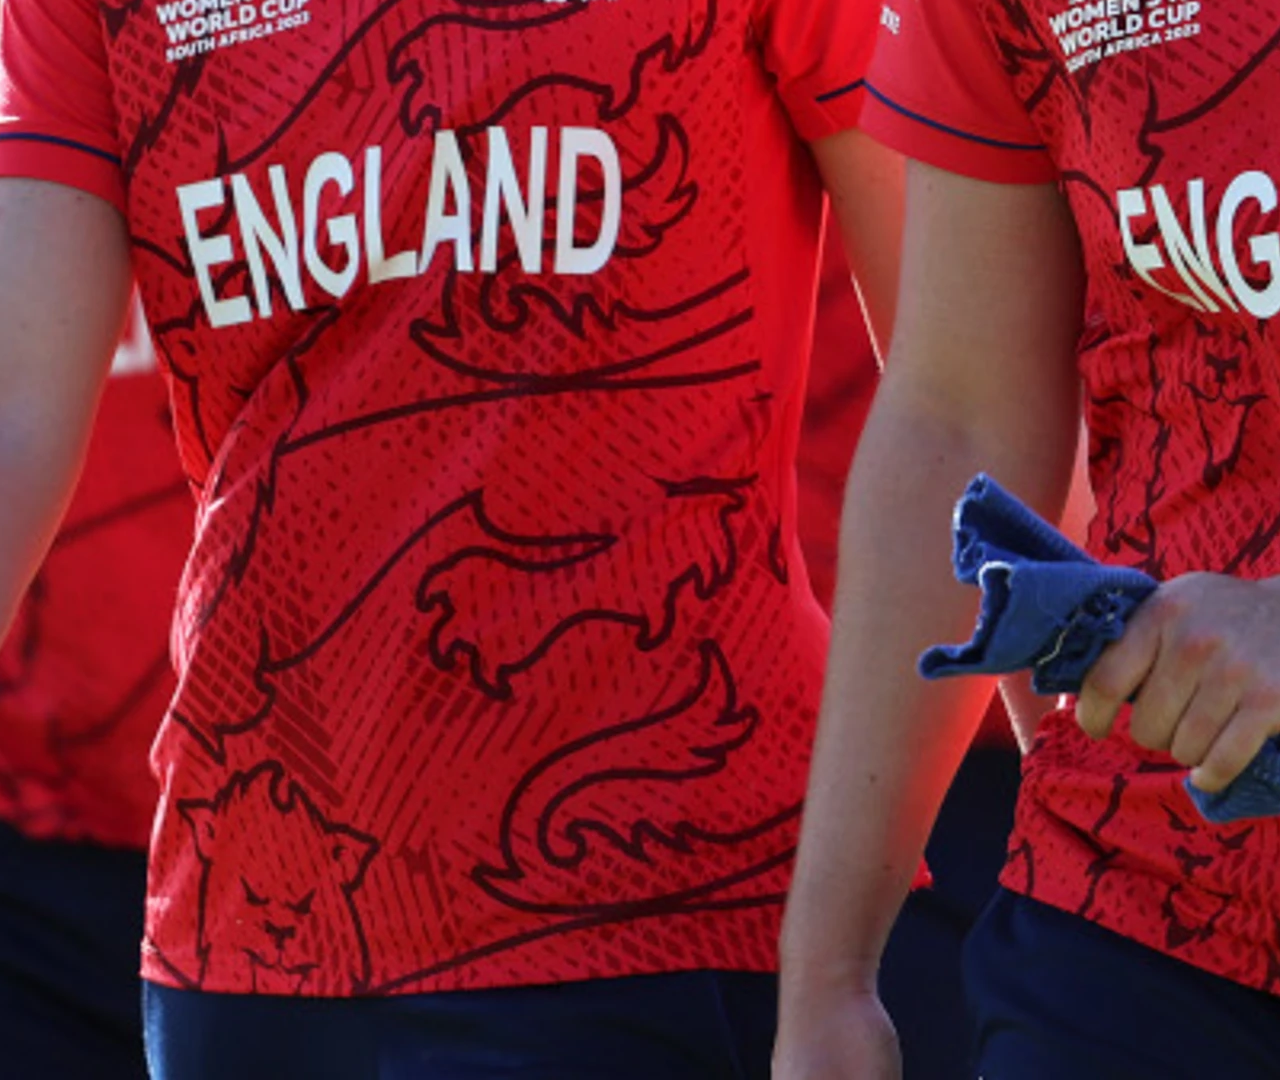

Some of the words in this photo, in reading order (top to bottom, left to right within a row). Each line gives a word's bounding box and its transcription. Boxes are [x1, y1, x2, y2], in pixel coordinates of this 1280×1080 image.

[166, 5, 256, 43] WORLD
[166, 37, 215, 63] SOUTH
[218, 22, 273, 47] AFRICA
[1059, 14, 1142, 56] WORLD
[1148, 1, 1201, 28] CUP
[1104, 32, 1161, 57] AFRICA
[175, 125, 622, 328] ENGLAND
